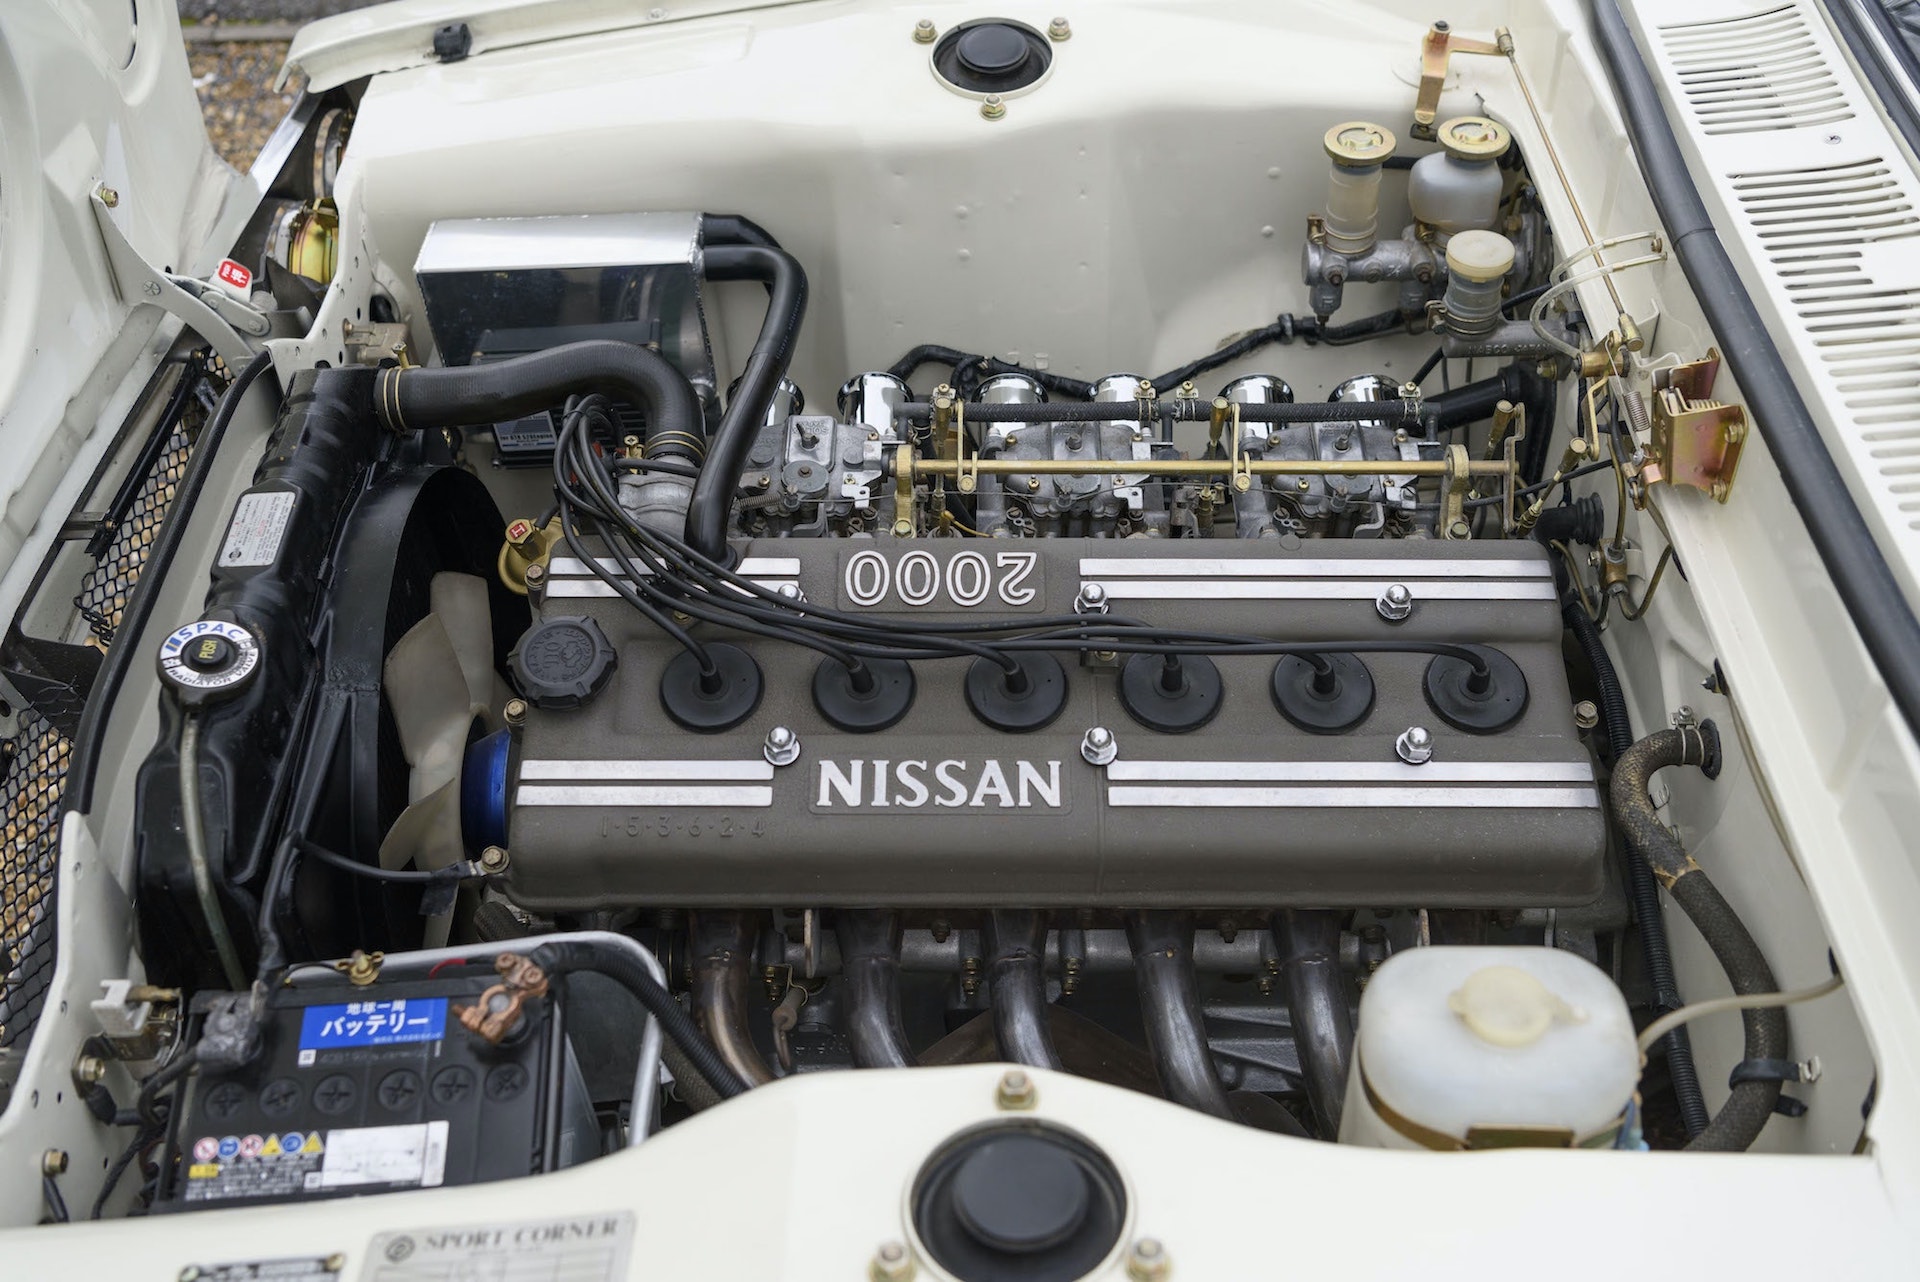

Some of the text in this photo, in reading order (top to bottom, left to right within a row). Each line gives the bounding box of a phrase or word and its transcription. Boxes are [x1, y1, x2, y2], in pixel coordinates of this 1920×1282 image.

[845, 550, 1038, 607] 2000
[199, 639, 218, 659] PUSH
[169, 669, 231, 686] RADIATOR
[816, 759, 1062, 808] NISSAN
[320, 1012, 429, 1037] バッテリー
[514, 1217, 619, 1243] CORNER
